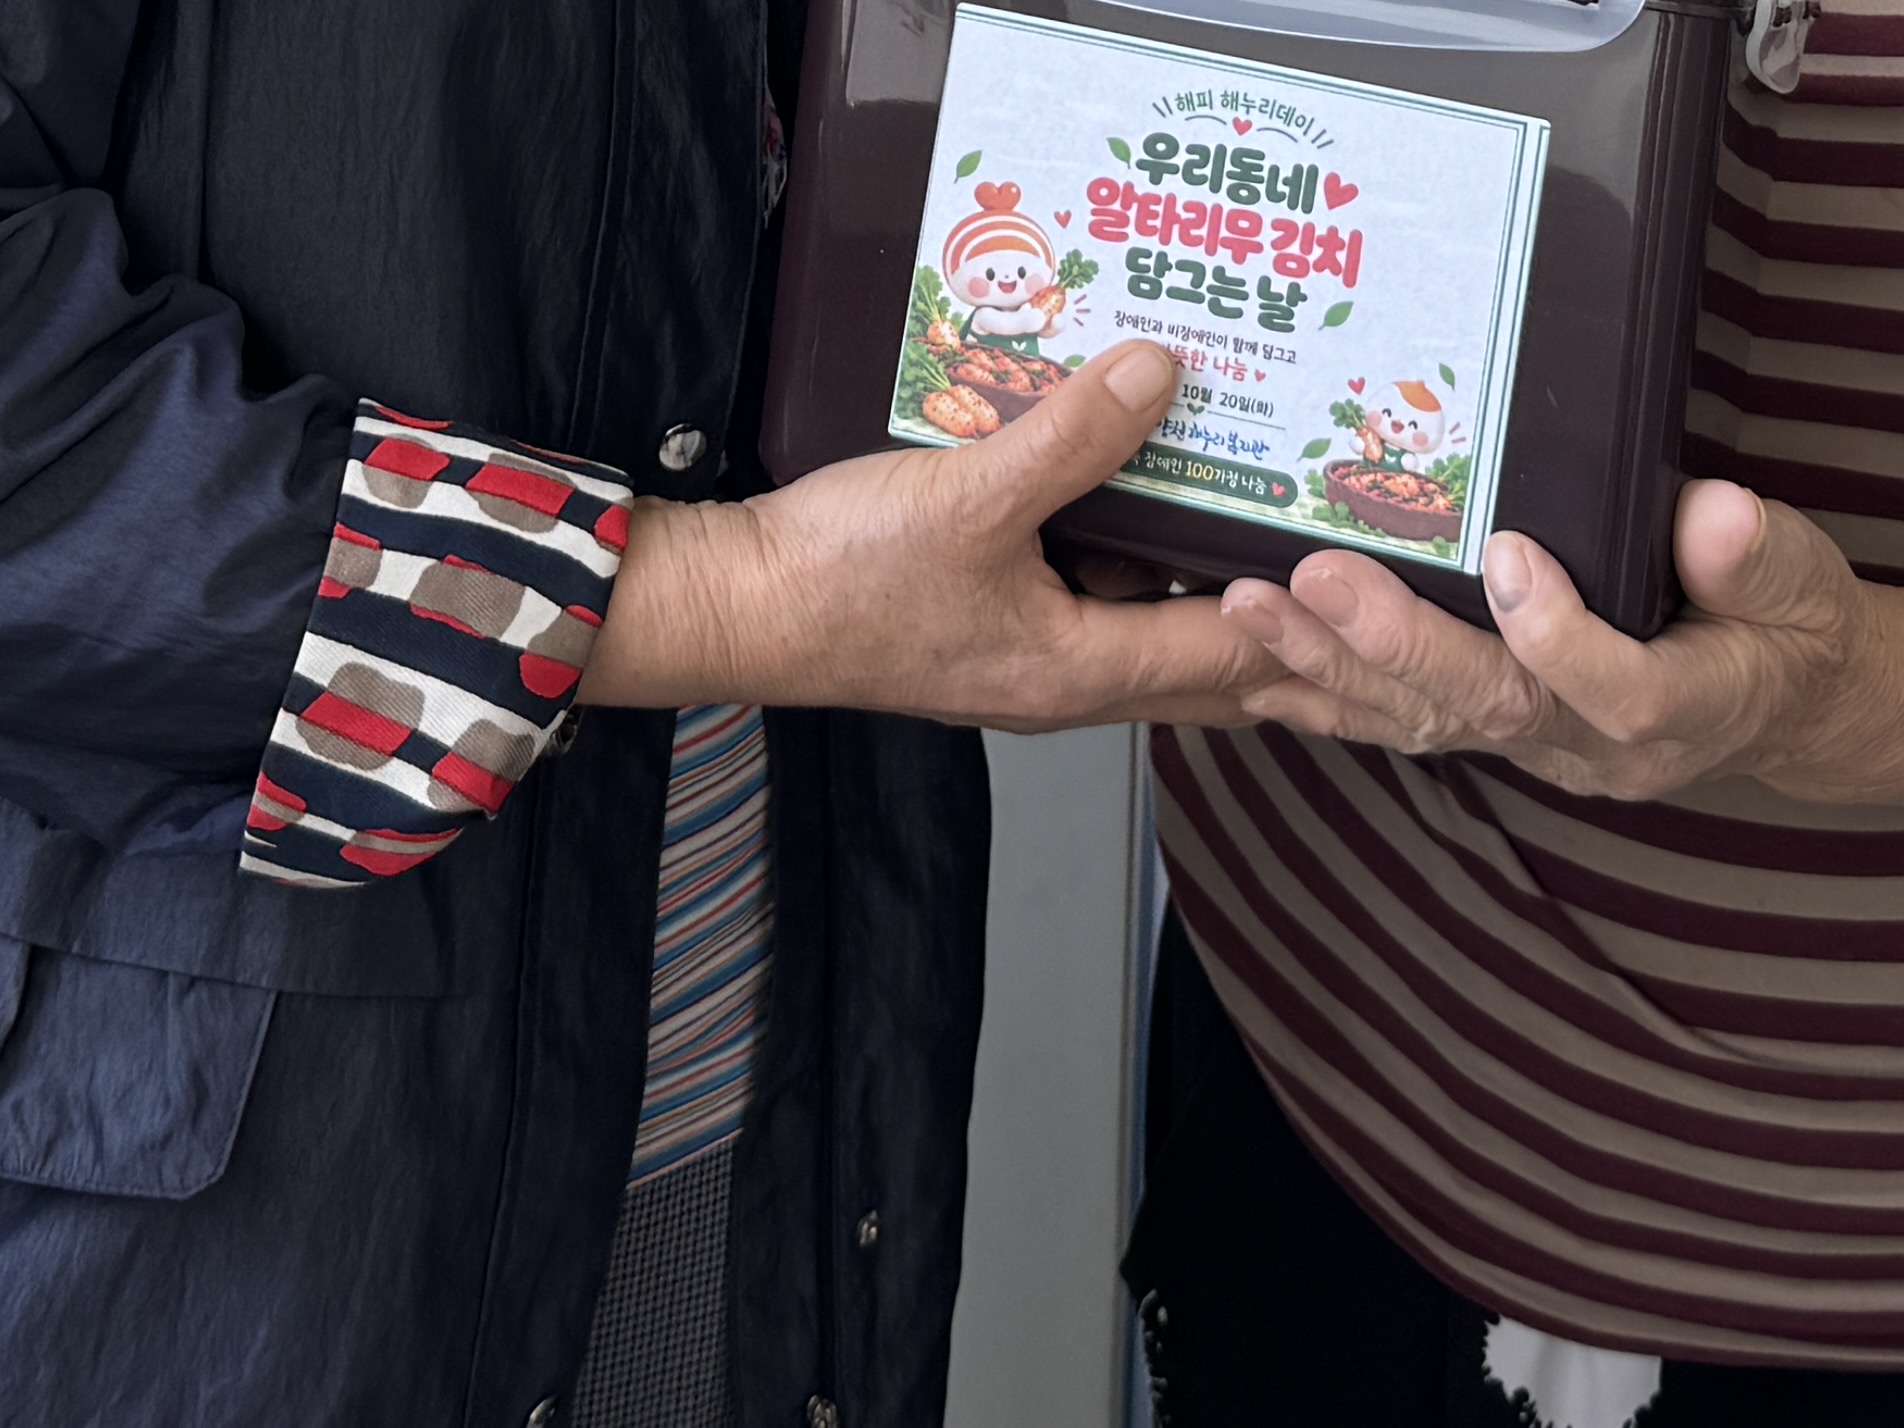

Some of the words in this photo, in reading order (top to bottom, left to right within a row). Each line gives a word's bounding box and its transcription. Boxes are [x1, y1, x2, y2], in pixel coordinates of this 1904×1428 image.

[1174, 89, 1213, 112] 해피
[1219, 89, 1314, 136] 해누리데이
[1135, 131, 1319, 215] 우리동네
[1086, 176, 1264, 265] 알타리무
[1270, 217, 1363, 288] 김치
[1125, 246, 1250, 320] 담그는
[1256, 274, 1308, 333] 날
[1212, 353, 1249, 382] 나눔
[1181, 383, 1212, 404] 10월
[1241, 474, 1268, 495] 나눔
